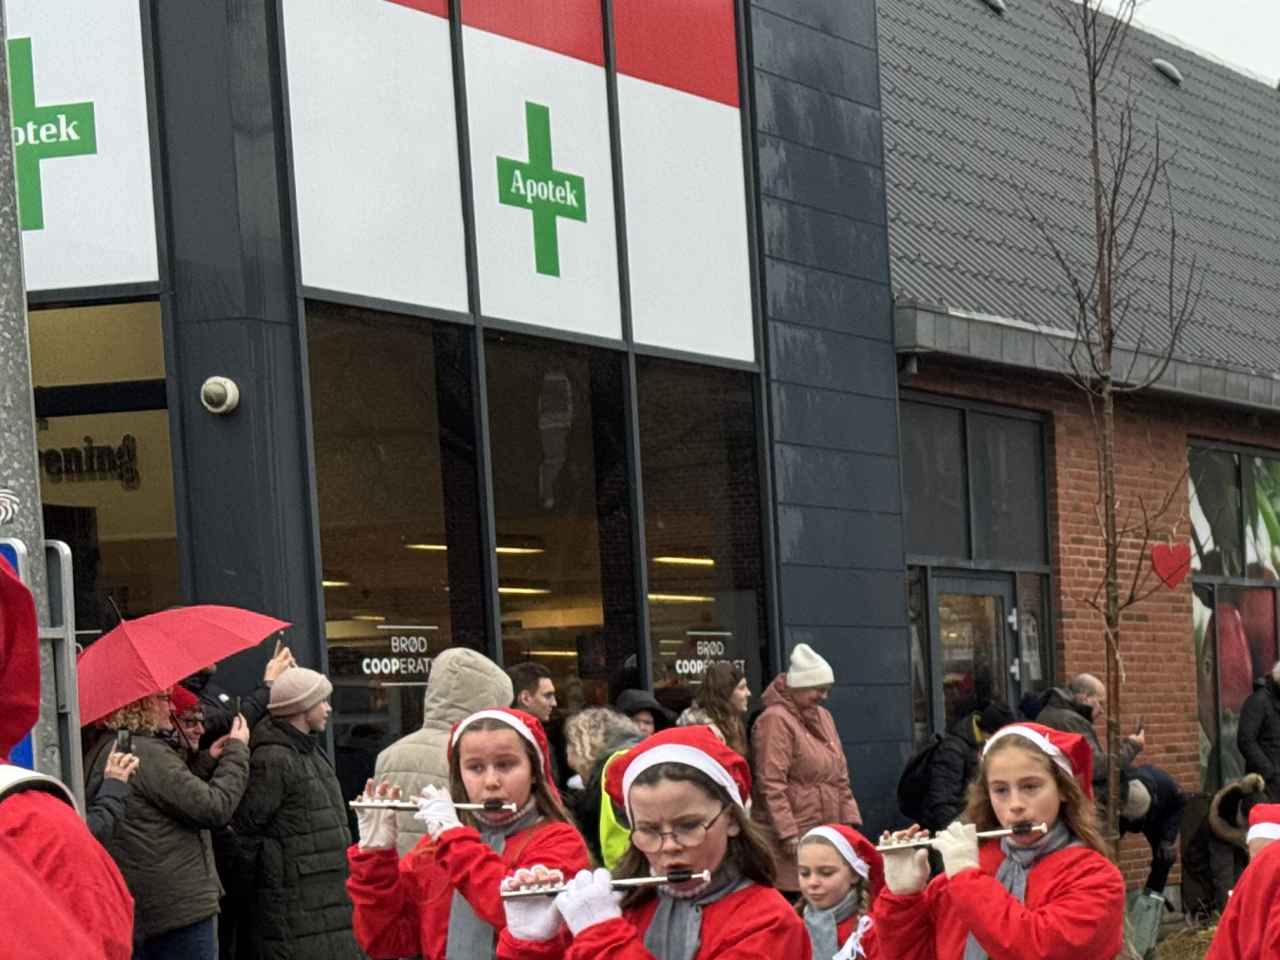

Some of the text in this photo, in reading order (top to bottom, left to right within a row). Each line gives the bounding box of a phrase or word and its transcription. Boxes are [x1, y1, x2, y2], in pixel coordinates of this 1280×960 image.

[12, 114, 80, 146] otek
[510, 169, 578, 207] Apotek
[38, 434, 139, 490] ening
[391, 636, 428, 653] BRØD
[696, 641, 725, 656] BRØD
[362, 657, 432, 674] COOPERAT
